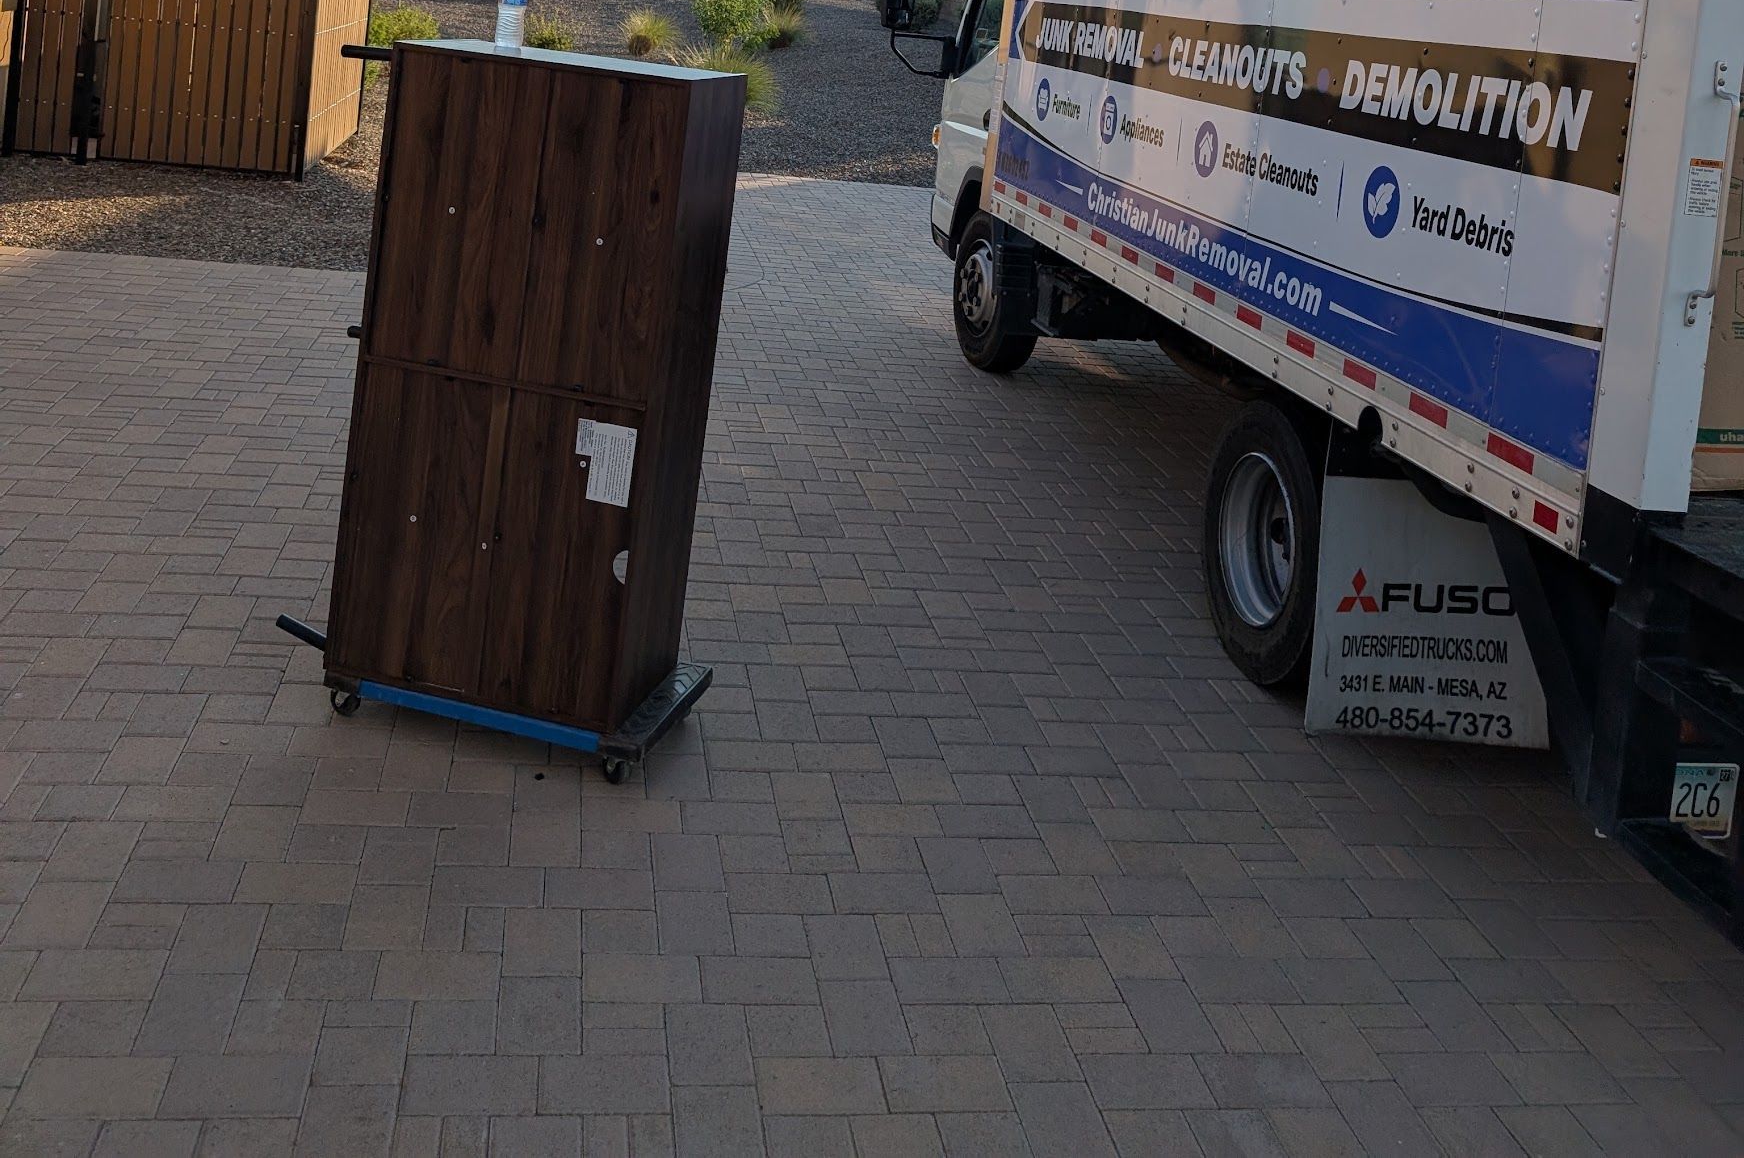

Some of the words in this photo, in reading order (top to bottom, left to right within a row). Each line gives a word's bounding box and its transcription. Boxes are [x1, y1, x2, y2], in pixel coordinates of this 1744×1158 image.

[1036, 18, 1074, 53] JUNK
[1073, 22, 1144, 68] REMOVAL
[1168, 36, 1307, 99] CLEANOUTS
[1052, 93, 1081, 122] Furniture
[1339, 60, 1593, 152] DEMOLITION
[1120, 113, 1164, 148] Appliances
[1222, 143, 1257, 177] Estate
[1259, 152, 1319, 197] Cleanouts
[1412, 196, 1451, 237] Yard
[1451, 207, 1515, 257] Debris
[1087, 182, 1322, 316] ChristianJunkRemoval.com
[1382, 583, 1516, 617] FUSO
[1341, 635, 1508, 664] DIVERSIFIEDTRUCKS.COM
[1339, 674, 1368, 693] 3431
[1372, 675, 1385, 692] E.
[1389, 675, 1424, 694] MAIN
[1437, 677, 1483, 701] MESA,
[1487, 681, 1507, 700] AZ
[1335, 706, 1513, 739] 480-854-7373
